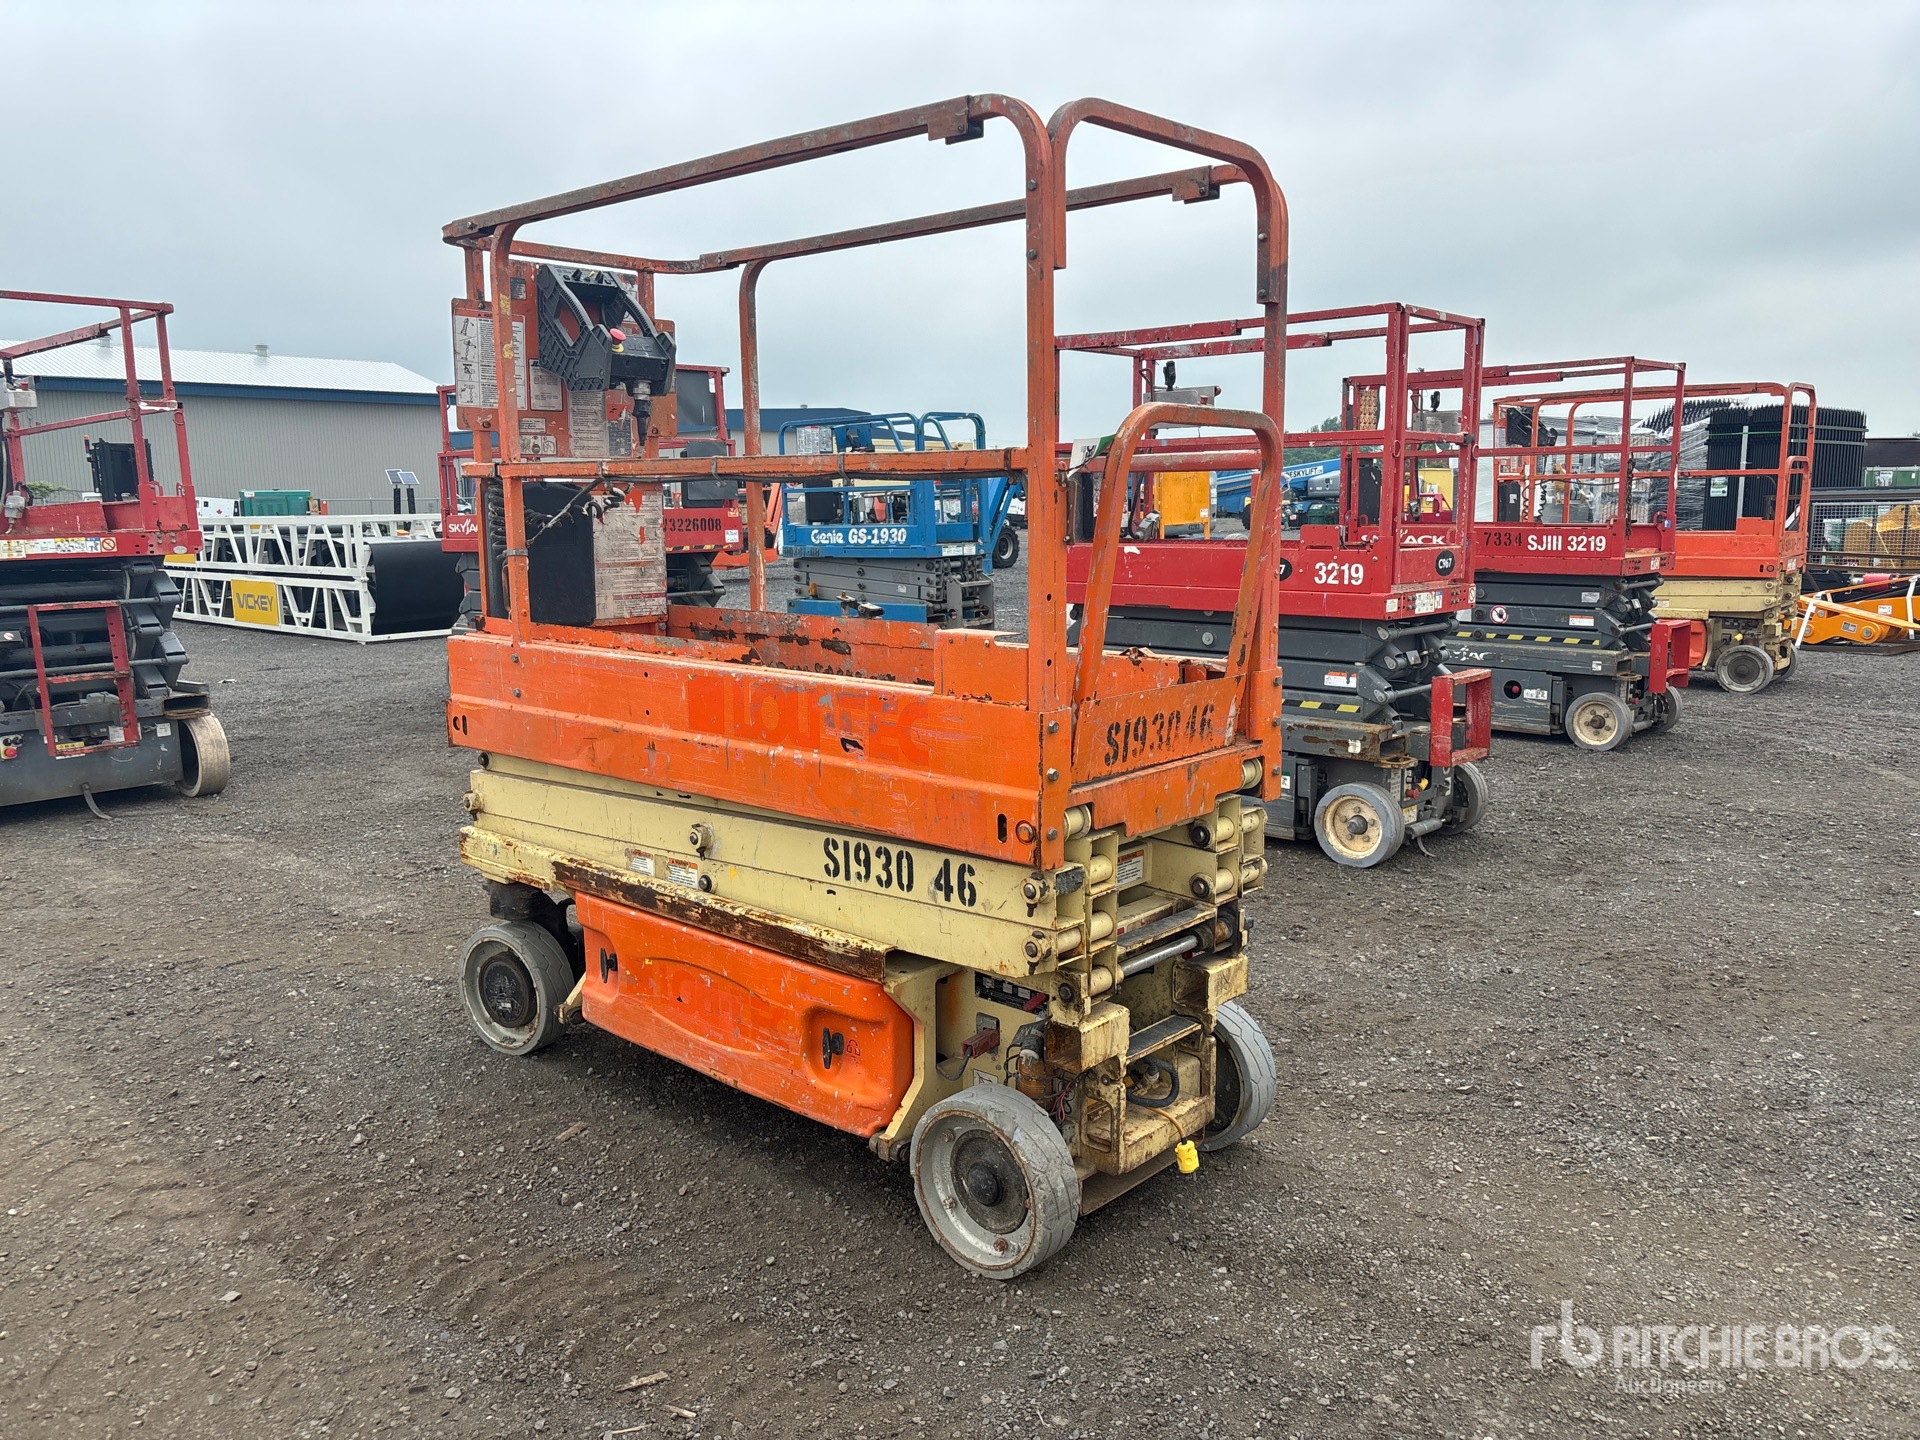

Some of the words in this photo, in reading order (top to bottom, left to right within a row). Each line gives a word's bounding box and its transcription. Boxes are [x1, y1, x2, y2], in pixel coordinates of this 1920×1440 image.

[811, 529, 844, 544] Genie
[848, 528, 907, 544] GS-1930
[1483, 532, 1522, 546] 7334
[1567, 535, 1607, 551] 3219
[1314, 562, 1364, 585] 3219
[934, 858, 977, 907] 46
